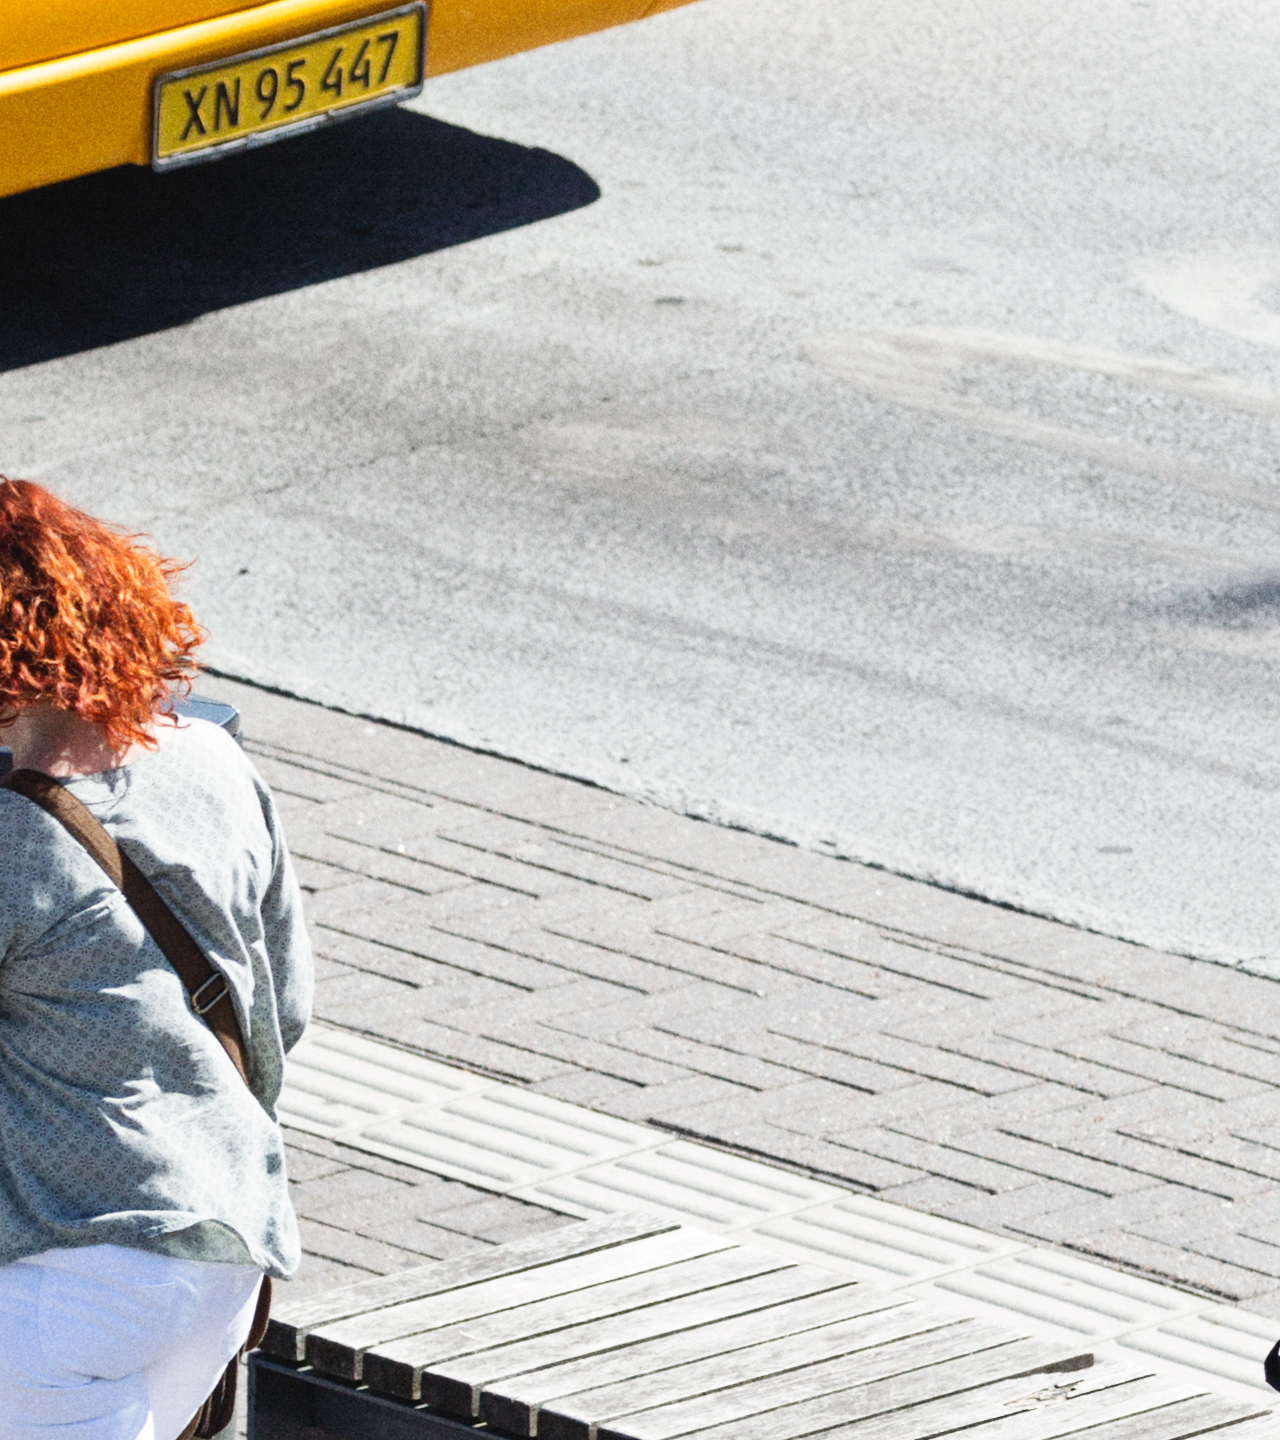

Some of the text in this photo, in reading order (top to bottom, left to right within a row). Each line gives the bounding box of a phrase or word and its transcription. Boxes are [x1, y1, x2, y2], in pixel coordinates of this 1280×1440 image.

[179, 30, 400, 141] XN 95 447
